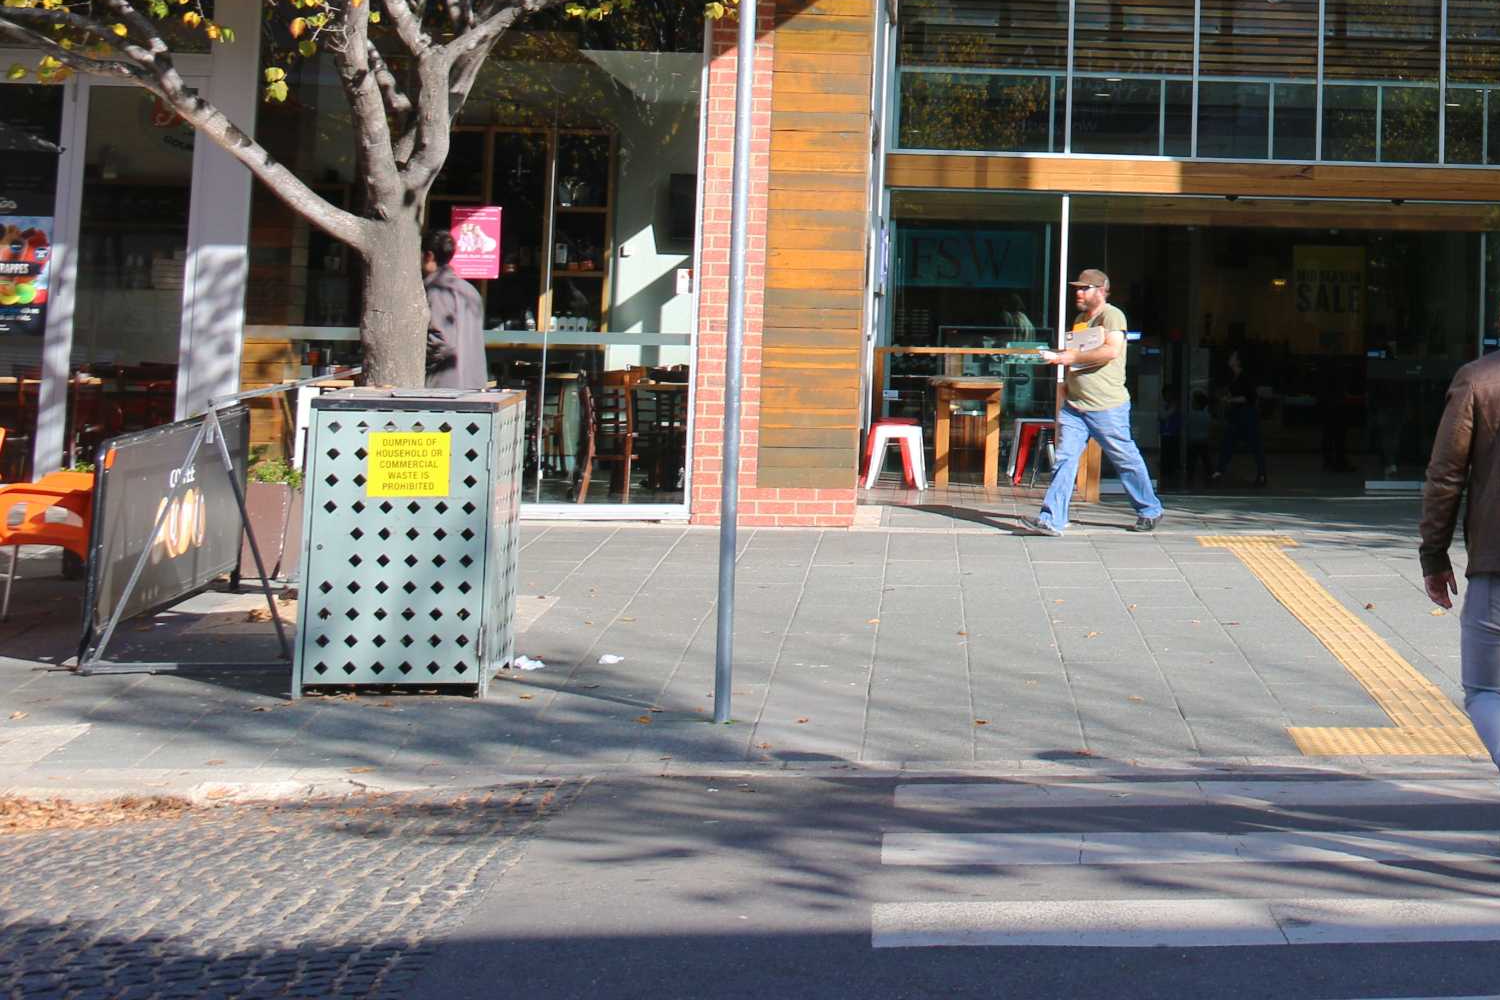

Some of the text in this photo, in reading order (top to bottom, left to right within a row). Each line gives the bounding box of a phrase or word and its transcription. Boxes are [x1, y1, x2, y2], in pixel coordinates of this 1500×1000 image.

[1297, 283, 1362, 314] SALE
[382, 438, 438, 447] DUMPING OF
[376, 449, 443, 458] HOUSEHOLD OR
[379, 460, 439, 469] COMMERCIAL
[387, 471, 430, 480] WASTE IS
[382, 482, 435, 490] PROHIBITED
